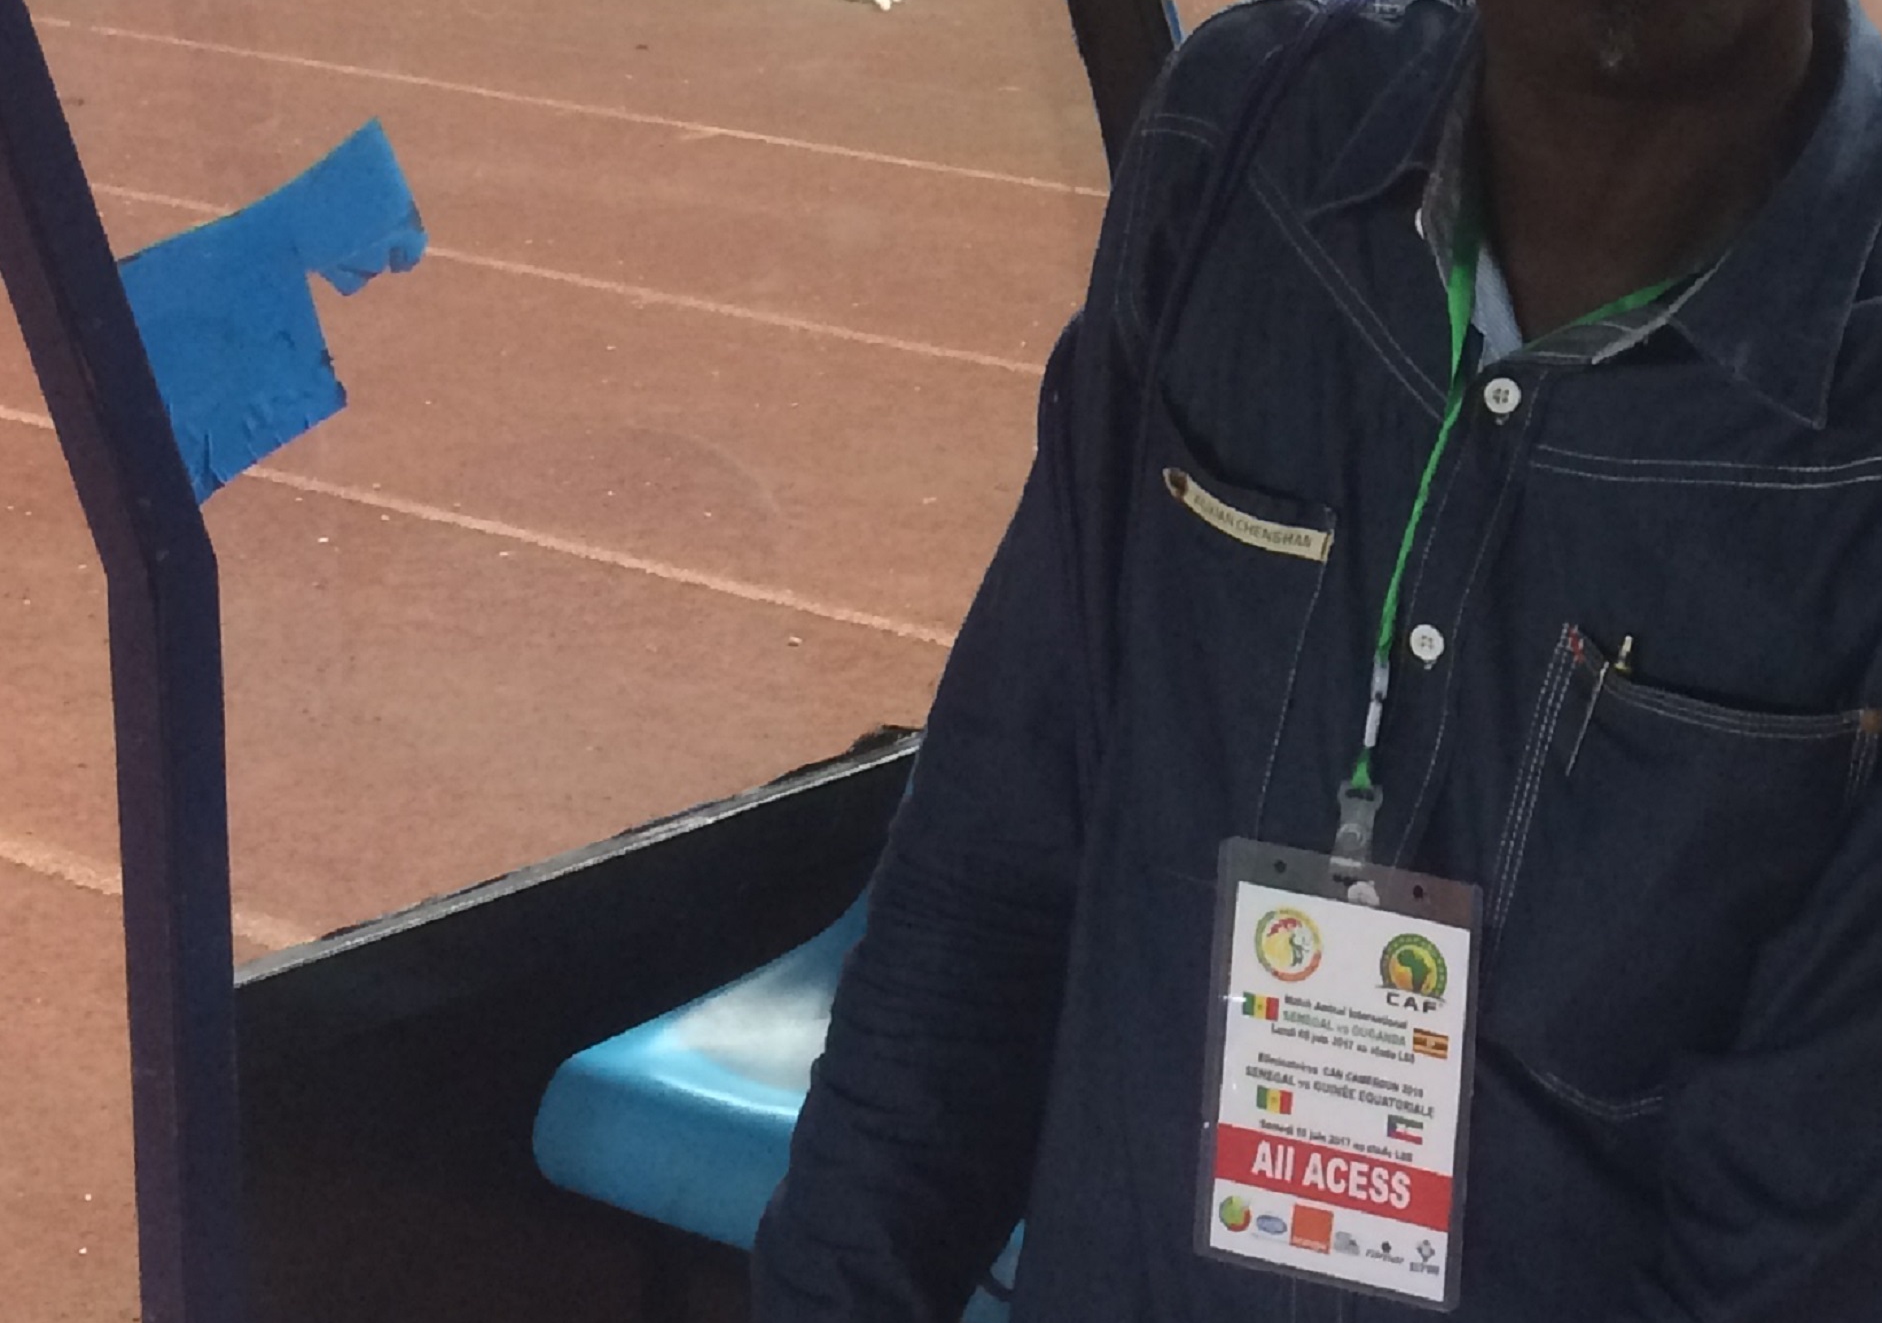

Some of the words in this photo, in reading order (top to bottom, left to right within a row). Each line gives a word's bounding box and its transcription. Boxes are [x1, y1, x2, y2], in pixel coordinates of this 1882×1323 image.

[1386, 991, 1438, 1014] CAF
[1351, 1024, 1406, 1046] OUGANDA
[1323, 1066, 1343, 1080] CAN
[1251, 1139, 1296, 1182] All
[1302, 1152, 1412, 1210] ACESS
